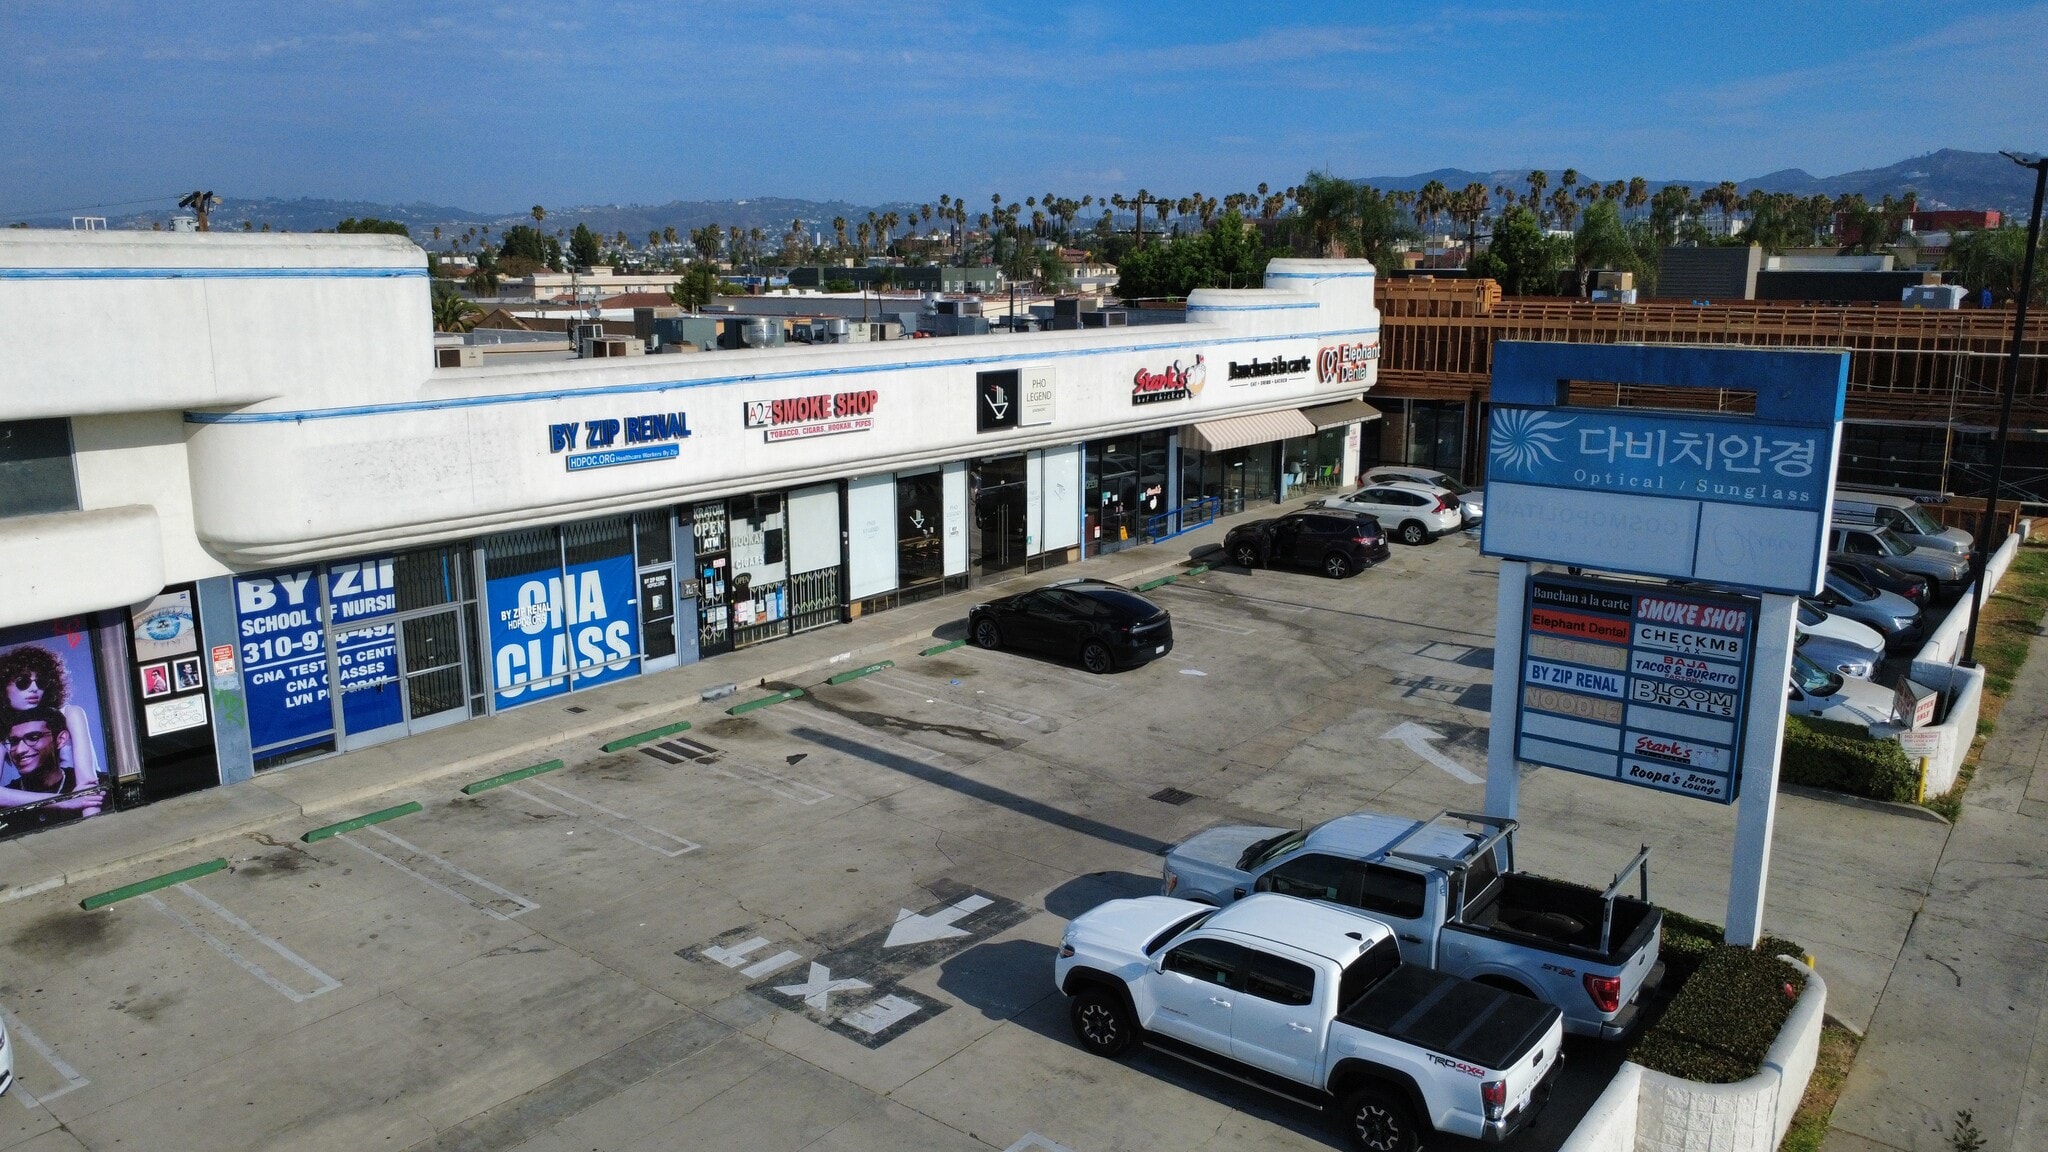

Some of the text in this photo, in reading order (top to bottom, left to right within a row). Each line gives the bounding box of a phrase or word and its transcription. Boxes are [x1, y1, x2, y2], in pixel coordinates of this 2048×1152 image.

[1341, 343, 1380, 361] Elephant
[1341, 363, 1367, 382] Dental
[1032, 379, 1047, 388] PHO
[1026, 391, 1052, 402] LEGEND
[749, 390, 878, 425] A2Z SMOKE SHOP
[549, 412, 691, 453] BY ZIP RENAL
[855, 420, 872, 428] PIPES
[570, 453, 616, 468] HDPOC.ORG
[616, 453, 641, 462] Healthcare
[643, 450, 662, 459] Workers
[663, 449, 670, 457] By
[1578, 425, 1816, 478] 다비치안경
[1573, 469, 1810, 501] Optical / Sunglass
[694, 504, 724, 519] KRATOM
[694, 520, 724, 537] OPEN
[704, 537, 719, 548] ATM
[237, 570, 313, 614] BY
[1534, 587, 1578, 601] Banchan
[1590, 594, 1599, 606] la
[1602, 599, 1630, 610] carte
[501, 609, 512, 621] BY
[527, 602, 551, 616] RENAL
[1638, 598, 1699, 625] SMOKE
[241, 611, 311, 637] SCHOOL
[1533, 615, 1627, 638] Elephant Dental
[1641, 628, 1738, 653] CHECKM8
[1676, 645, 1700, 654] TAX
[496, 620, 631, 698] CLASS
[1664, 656, 1708, 670] BAJA
[252, 669, 285, 685] CNA
[286, 662, 385, 693] CNA CASSES
[1532, 665, 1618, 693] BY ZIP RENAL
[1636, 660, 1736, 684] TACOS & BURRITO
[1664, 674, 1703, 684] FACTORY
[285, 693, 313, 709] LVN
[1633, 678, 1733, 708] BLOOM
[1527, 688, 1619, 722] NOODLE
[1659, 696, 1731, 716] NAILS
[1630, 765, 1716, 787] Roopa's Brow
[1682, 781, 1721, 795] Lounge
[1541, 963, 1576, 977] STX
[1426, 1053, 1456, 1068] TRD
